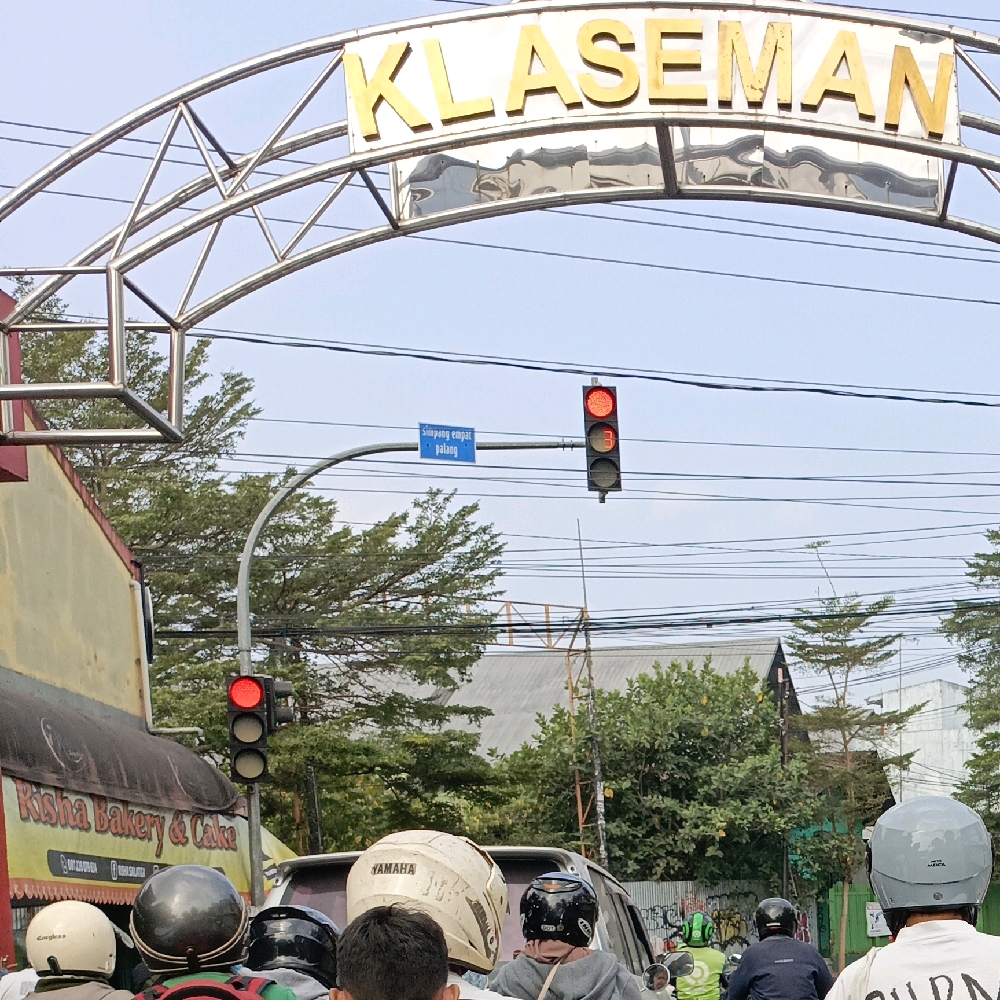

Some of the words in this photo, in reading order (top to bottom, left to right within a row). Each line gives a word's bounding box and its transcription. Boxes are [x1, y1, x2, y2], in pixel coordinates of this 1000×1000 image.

[342, 18, 954, 141] KLASEMAN
[451, 430, 473, 442] empat
[435, 443, 458, 458] palang
[15, 778, 91, 831] Risha
[93, 793, 165, 857] Bakery
[169, 810, 189, 846] &
[190, 813, 238, 851] Cake
[371, 863, 416, 875] YAMAHA
